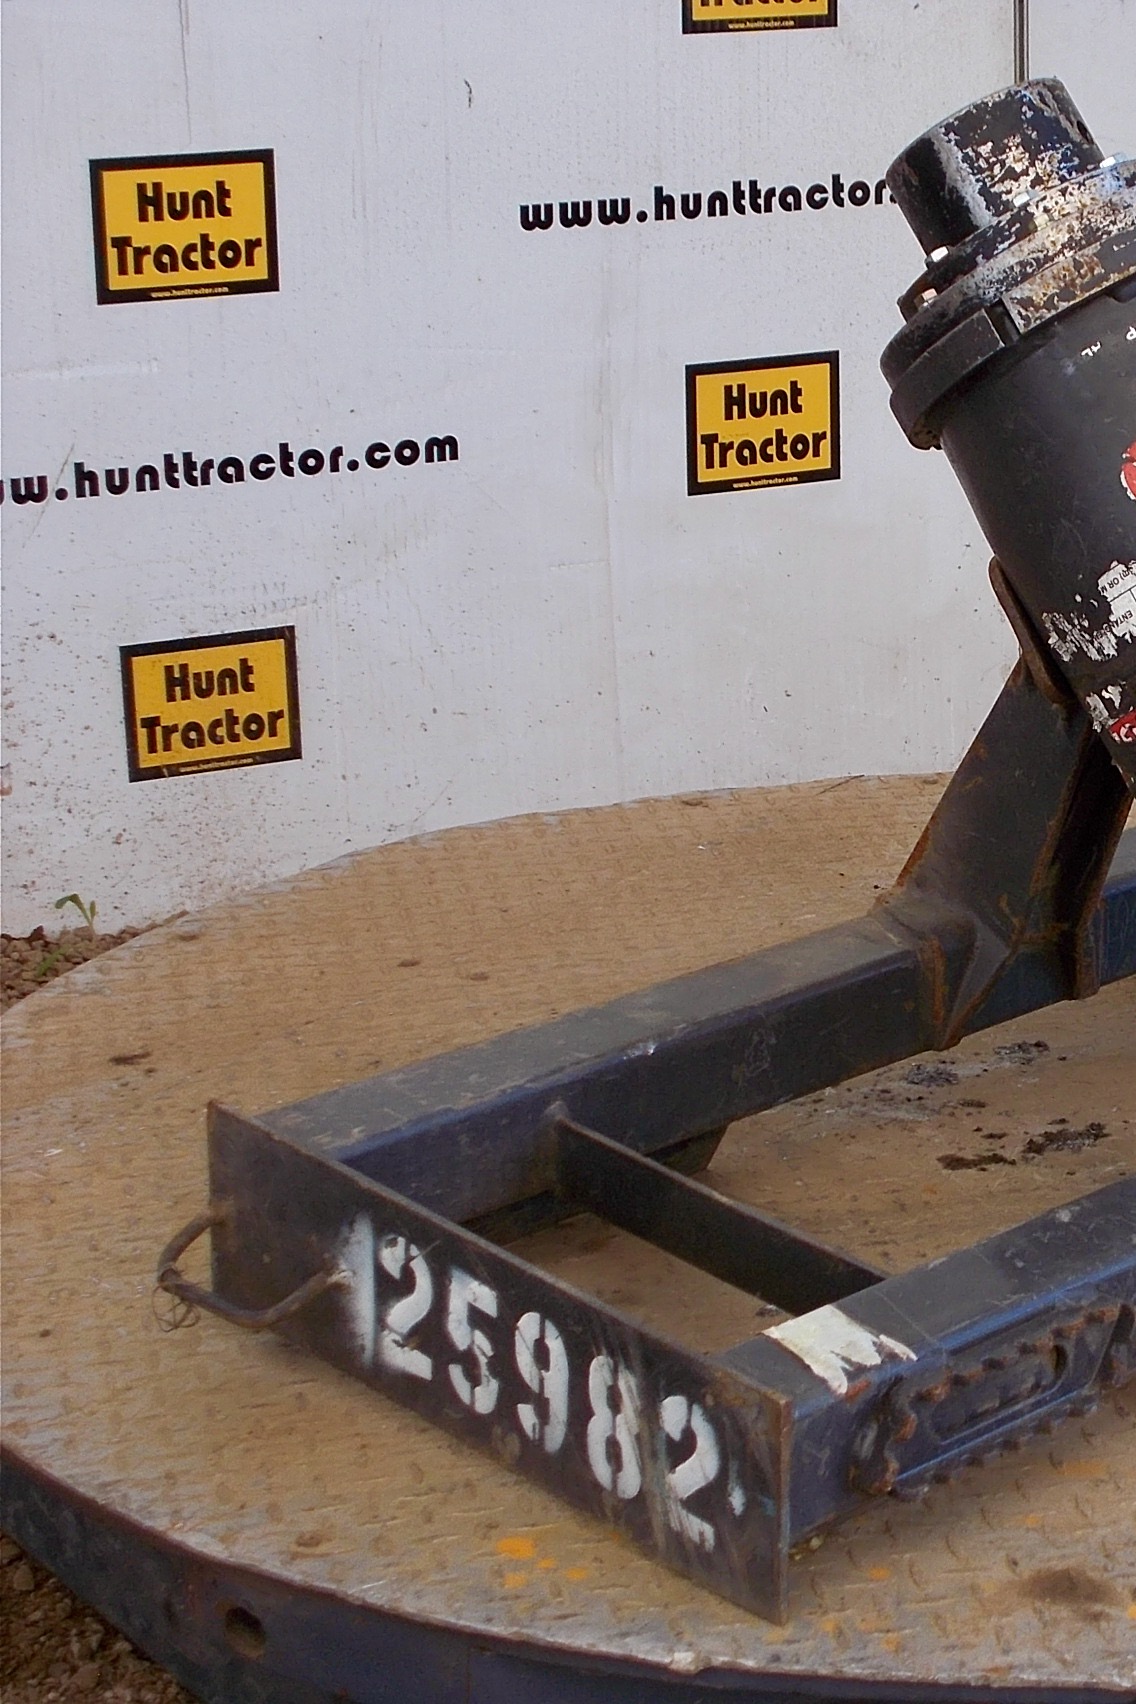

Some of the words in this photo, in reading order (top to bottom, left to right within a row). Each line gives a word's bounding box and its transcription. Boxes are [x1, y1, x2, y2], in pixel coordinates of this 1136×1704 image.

[136, 180, 232, 222] Hunt
[110, 233, 262, 276] Tractor
[723, 380, 803, 421] Hunt
[0, 434, 460, 506] w.hunttractor.com
[700, 428, 827, 470] Tractor
[1106, 577, 1120, 589] OR
[164, 658, 255, 703] Hunt
[140, 708, 284, 754] Tractor
